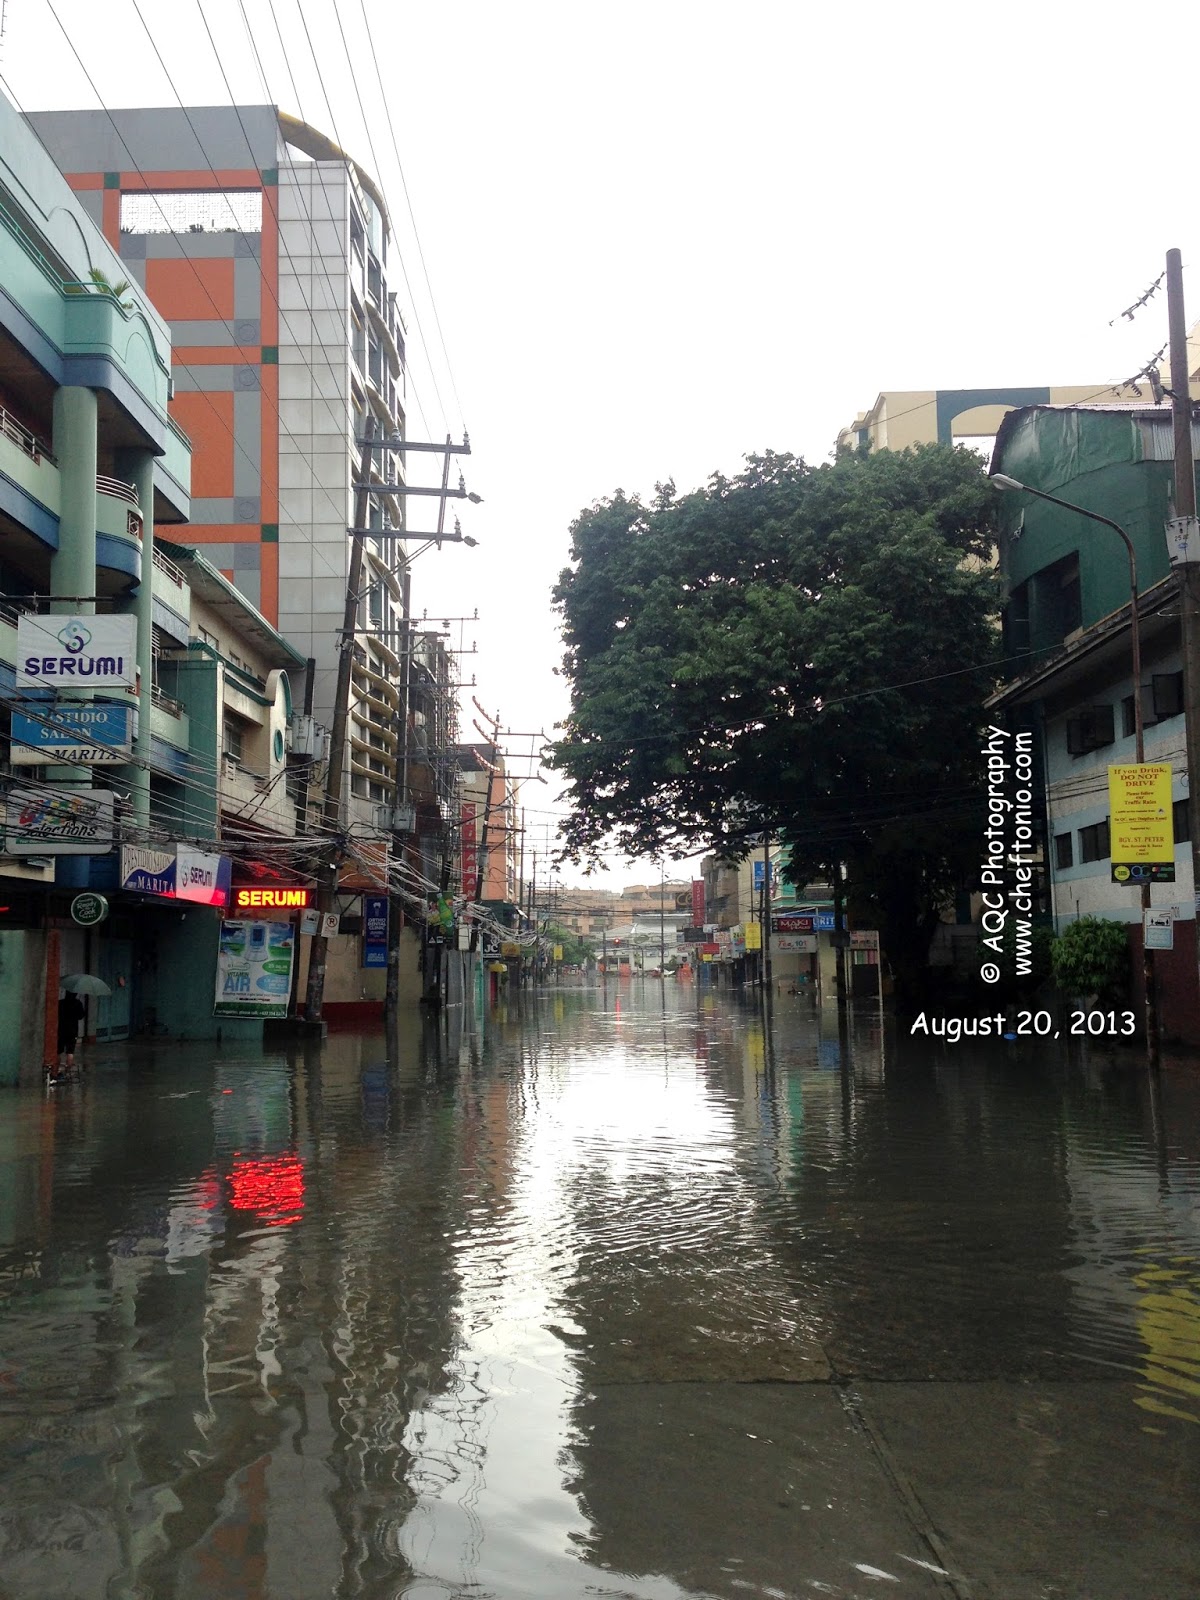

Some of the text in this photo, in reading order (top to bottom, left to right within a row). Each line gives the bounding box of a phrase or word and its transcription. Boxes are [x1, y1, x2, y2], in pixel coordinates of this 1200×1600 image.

[24, 656, 123, 676] SERUMI
[54, 749, 118, 760] MARITA
[137, 875, 175, 895] MARITA
[238, 890, 307, 907] SERUMI
[780, 919, 809, 928] MAKI
[484, 944, 499, 953] JC
[223, 976, 251, 992] AIR
